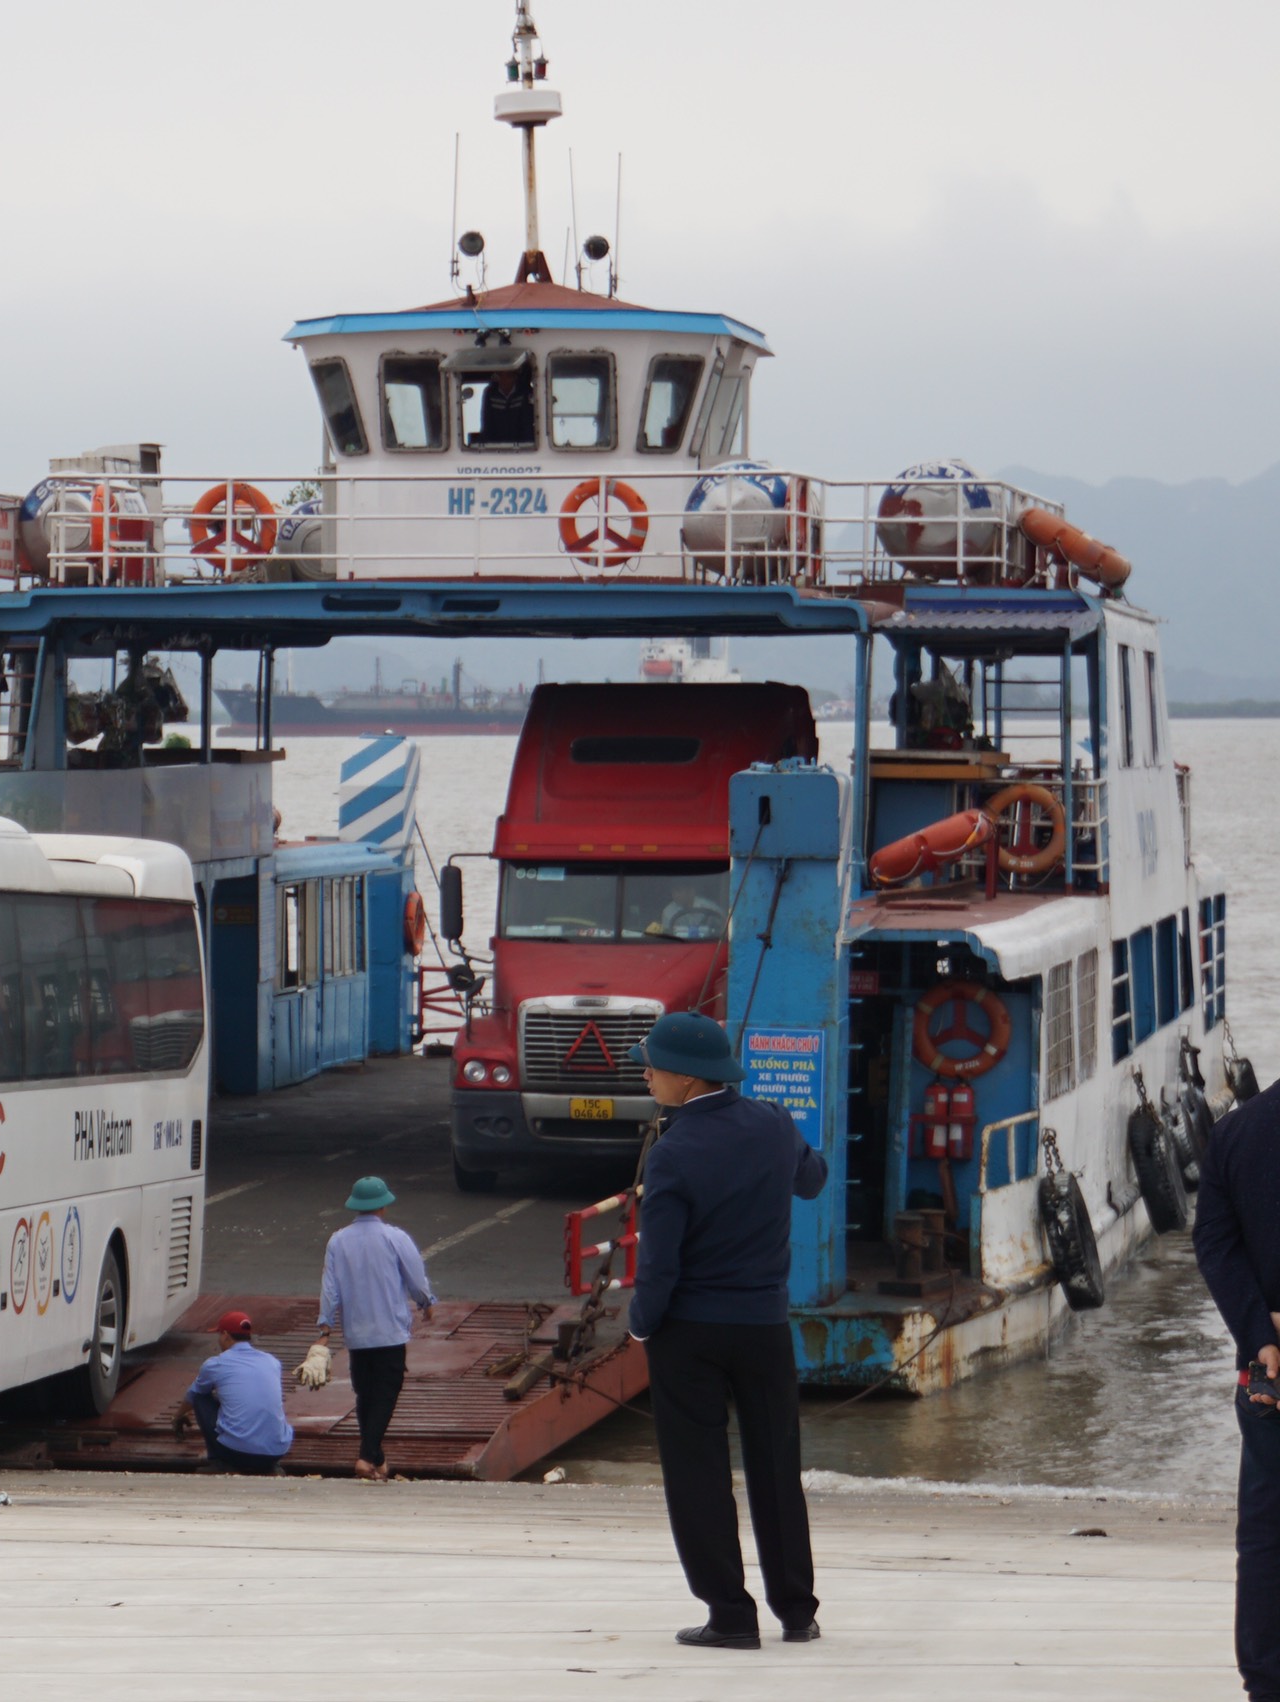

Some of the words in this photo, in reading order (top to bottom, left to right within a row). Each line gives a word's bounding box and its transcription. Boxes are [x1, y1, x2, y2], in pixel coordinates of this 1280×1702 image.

[792, 1059, 816, 1071] PHÀ
[758, 1073, 772, 1081] XE
[789, 1085, 812, 1094] SAU
[583, 1099, 601, 1109] 15C
[783, 1096, 818, 1109] PHÀ
[74, 1110, 94, 1160] PHA
[96, 1109, 132, 1158] Vietnam
